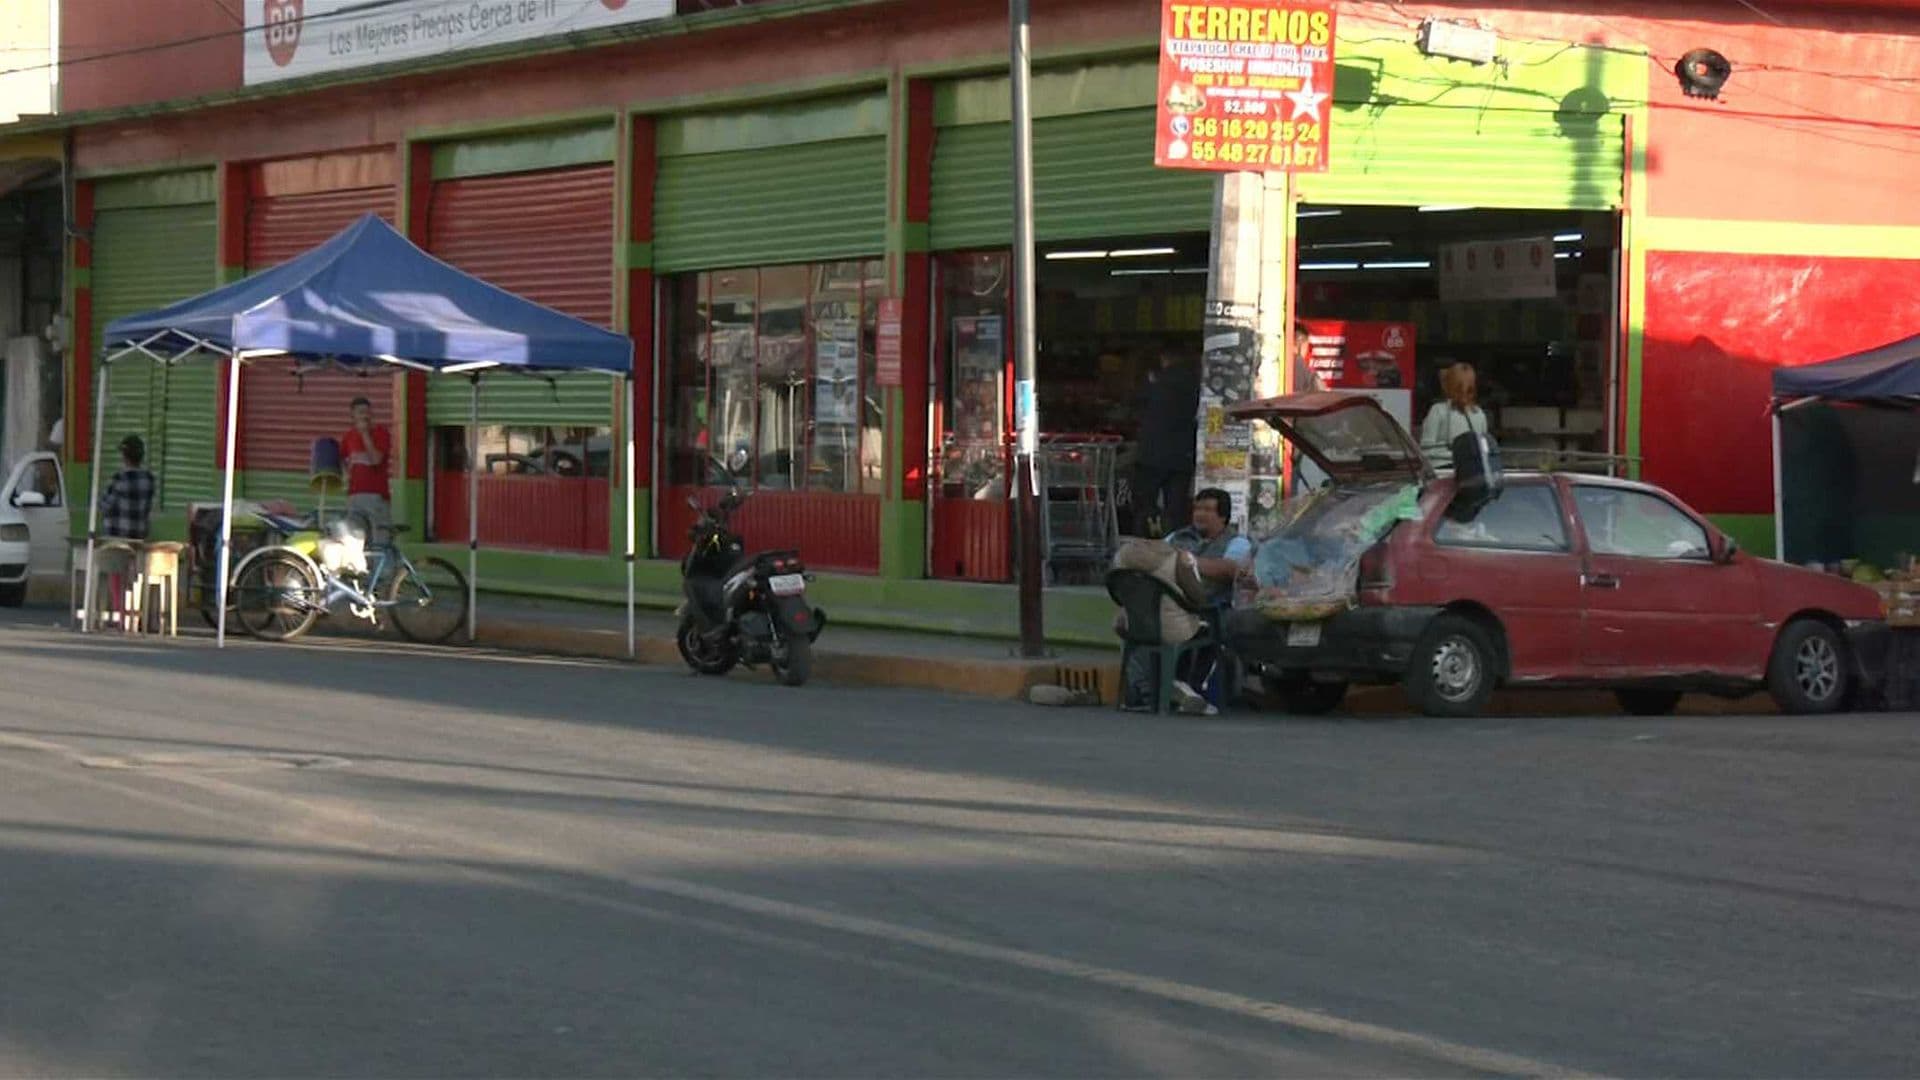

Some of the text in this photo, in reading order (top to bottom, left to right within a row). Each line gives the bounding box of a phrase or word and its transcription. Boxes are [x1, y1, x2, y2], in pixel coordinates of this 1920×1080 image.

[328, 28, 352, 56] Los
[354, 21, 409, 55] Mejores
[411, 12, 464, 40] Precios
[468, 3, 513, 31] Cerca
[517, 0, 537, 23] de
[1171, 5, 1329, 45] TERRENOS
[1192, 117, 1320, 143] 56 16 20 25 24
[1191, 141, 1216, 161] 55
[1218, 142, 1243, 163] 48
[1245, 143, 1269, 163] 27
[1270, 144, 1292, 165] 01
